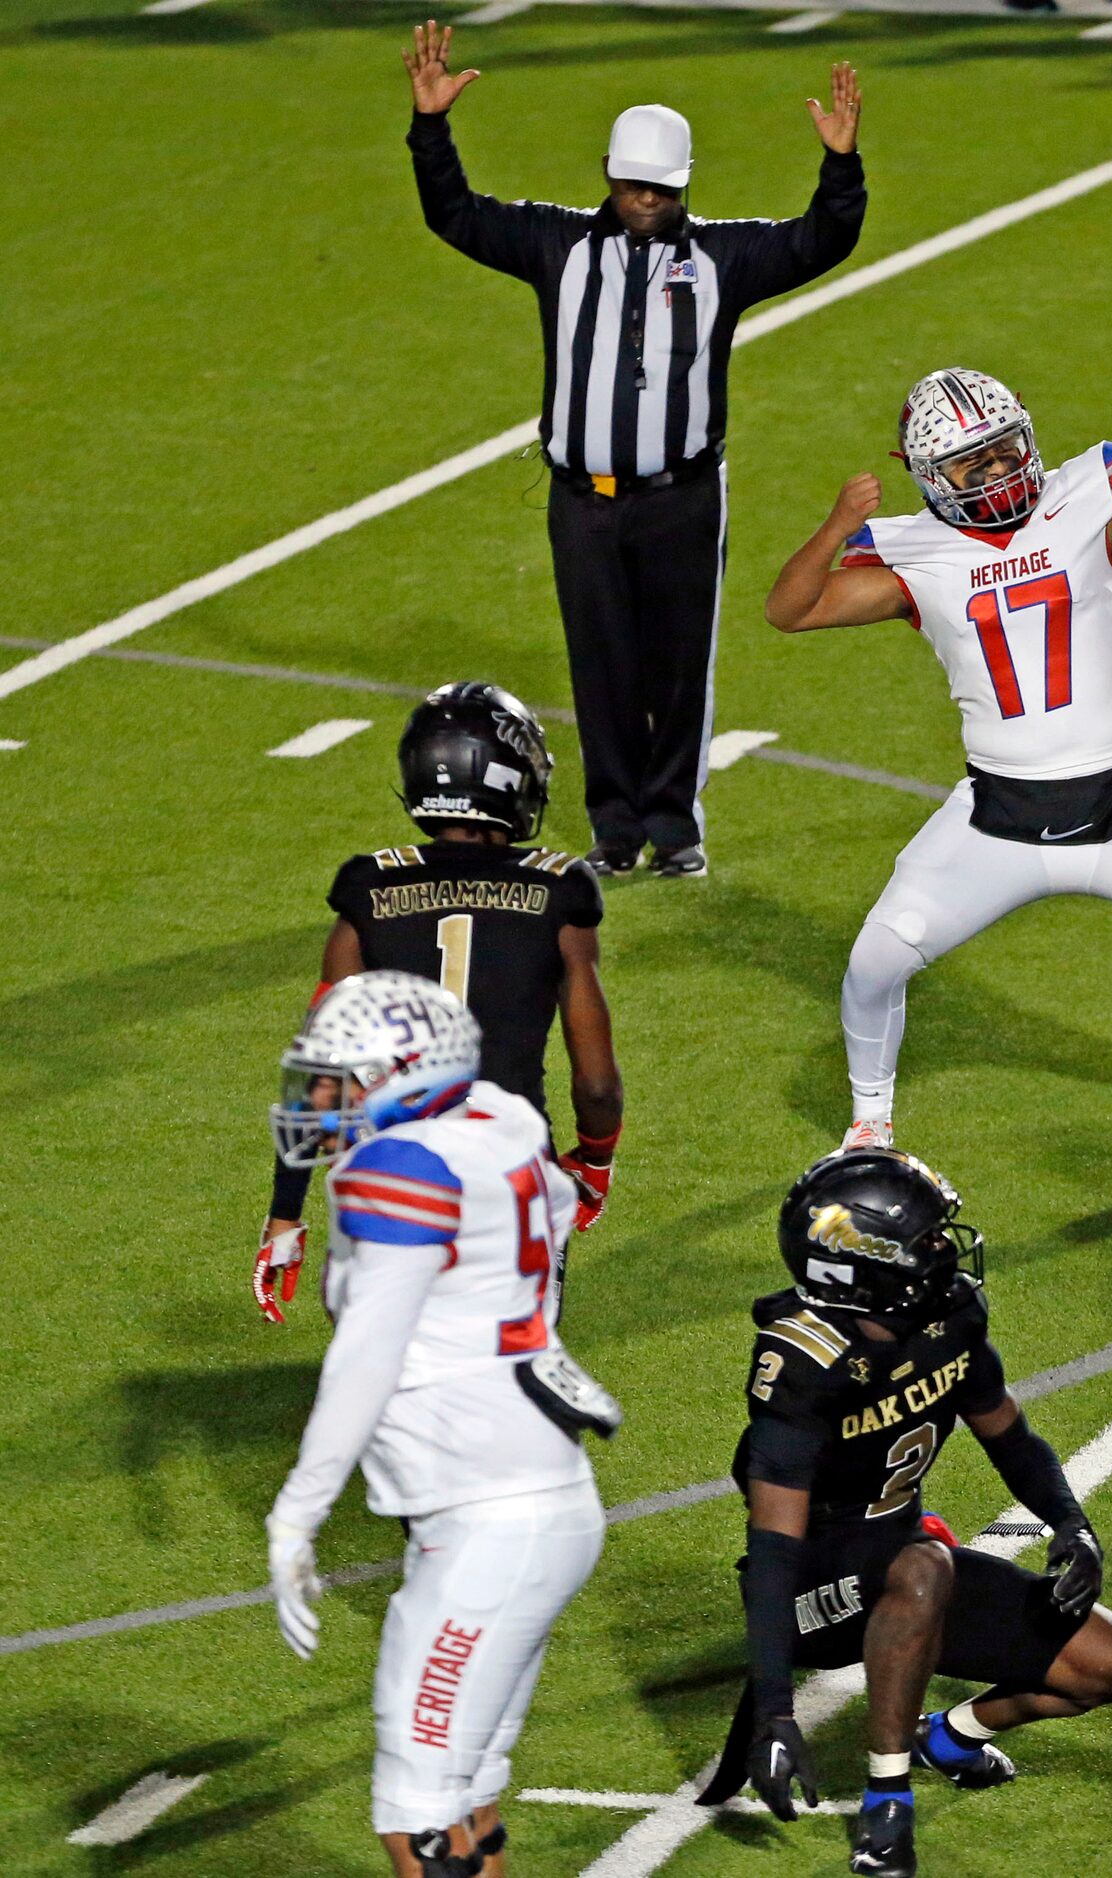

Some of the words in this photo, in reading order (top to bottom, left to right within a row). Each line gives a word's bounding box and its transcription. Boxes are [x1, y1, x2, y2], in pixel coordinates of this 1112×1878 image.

[971, 548, 1052, 588] HERITAGE
[966, 570, 1072, 720] 17
[422, 794, 471, 811] schutt
[370, 880, 549, 919] MUHAMMAD
[436, 914, 473, 1009] 1
[382, 1000, 436, 1046] 54
[751, 1351, 784, 1401] 2
[842, 1395, 903, 1439] OAK
[904, 1350, 970, 1413] CLIFF
[865, 1422, 937, 1519] 2
[411, 1618, 483, 1749] HERITAGE
